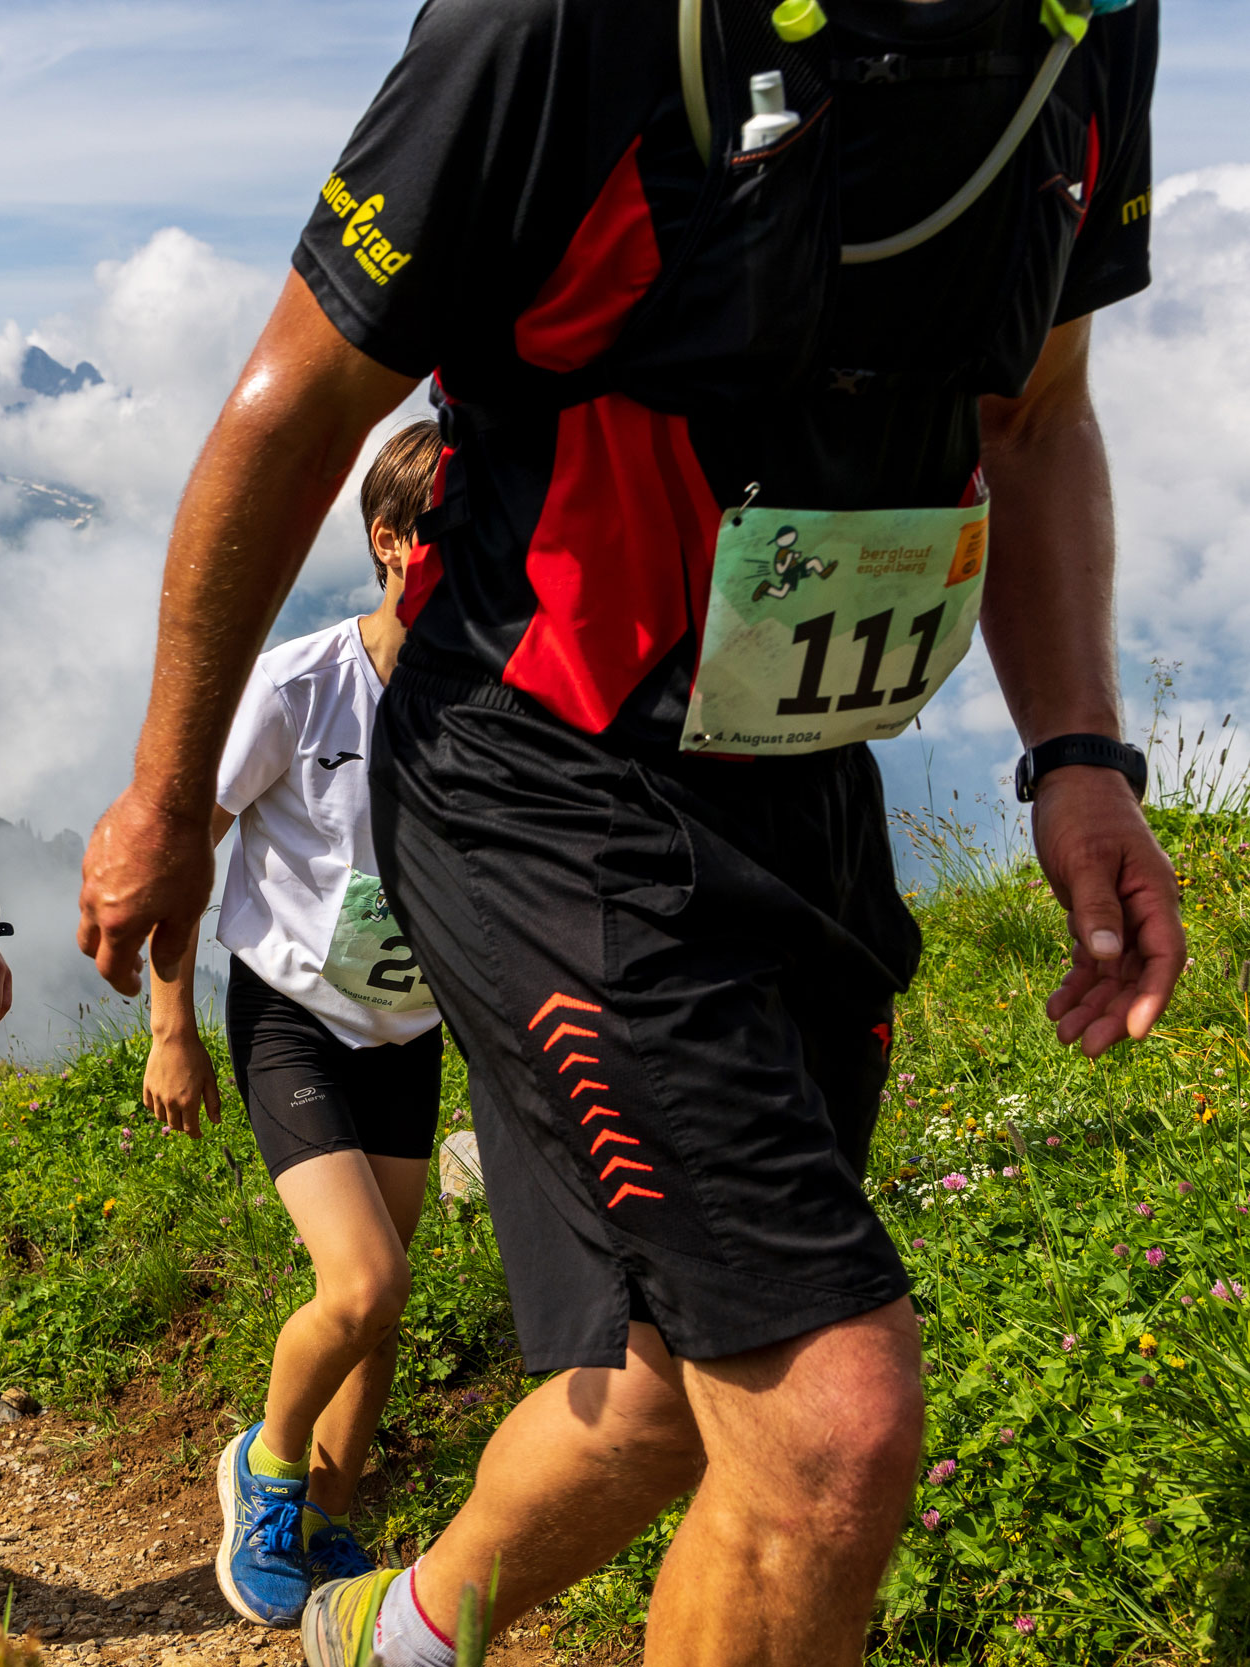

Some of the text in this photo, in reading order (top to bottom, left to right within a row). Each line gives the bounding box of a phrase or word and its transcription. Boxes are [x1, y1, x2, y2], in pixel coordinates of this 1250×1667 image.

[362, 227, 412, 276] rad
[859, 544, 933, 564] berglauf
[855, 560, 927, 578] engelberg
[776, 600, 947, 716] 111
[730, 732, 784, 747] August
[786, 730, 822, 744] 2024
[342, 987, 370, 1001] August
[371, 996, 393, 1006] 2024
